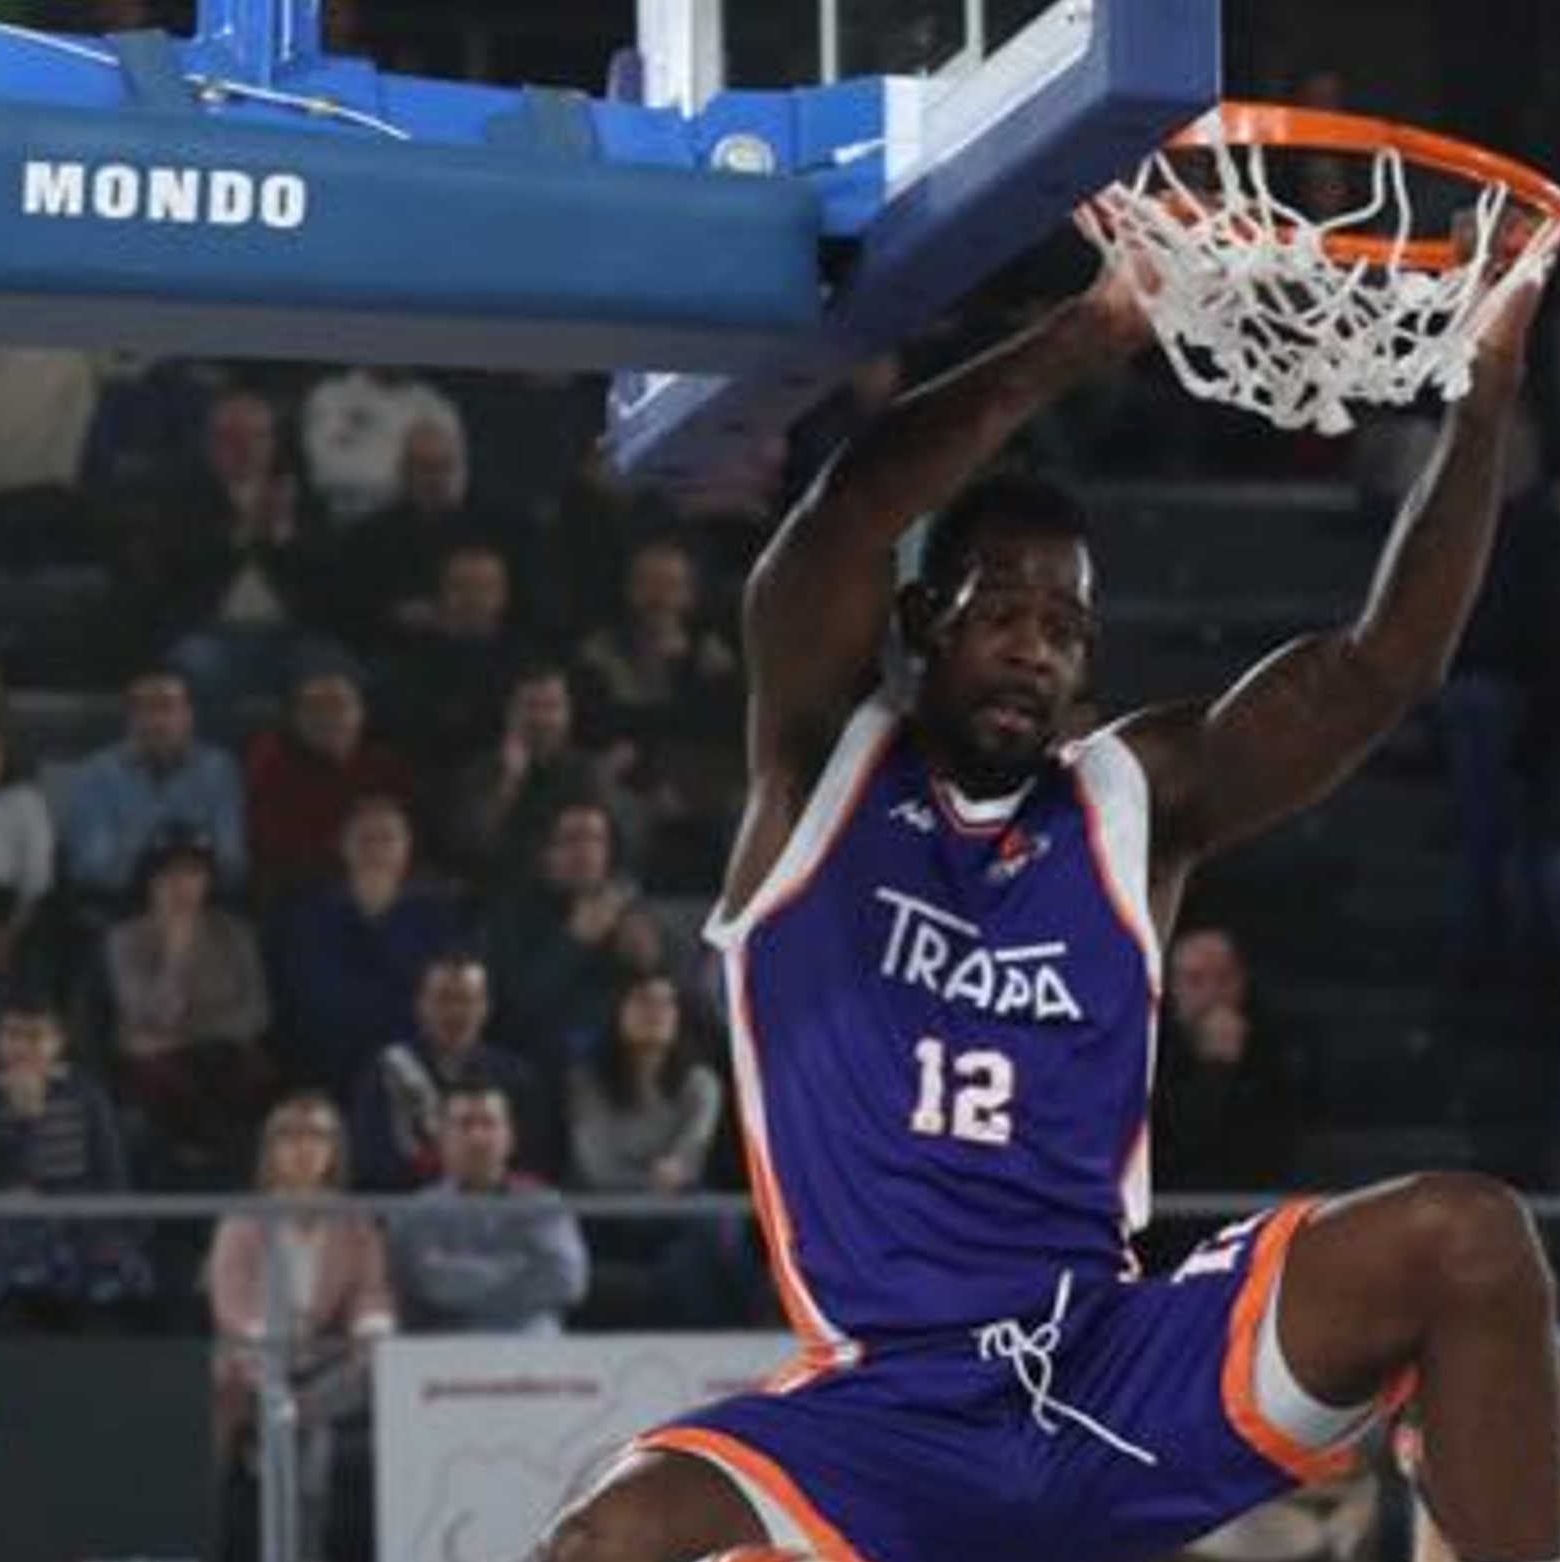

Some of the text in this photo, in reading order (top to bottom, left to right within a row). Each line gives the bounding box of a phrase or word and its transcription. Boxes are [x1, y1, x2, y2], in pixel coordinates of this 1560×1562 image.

[22, 160, 307, 229] MONDO
[875, 886, 1082, 1022] TRAPA
[911, 1036, 1014, 1145] 12
